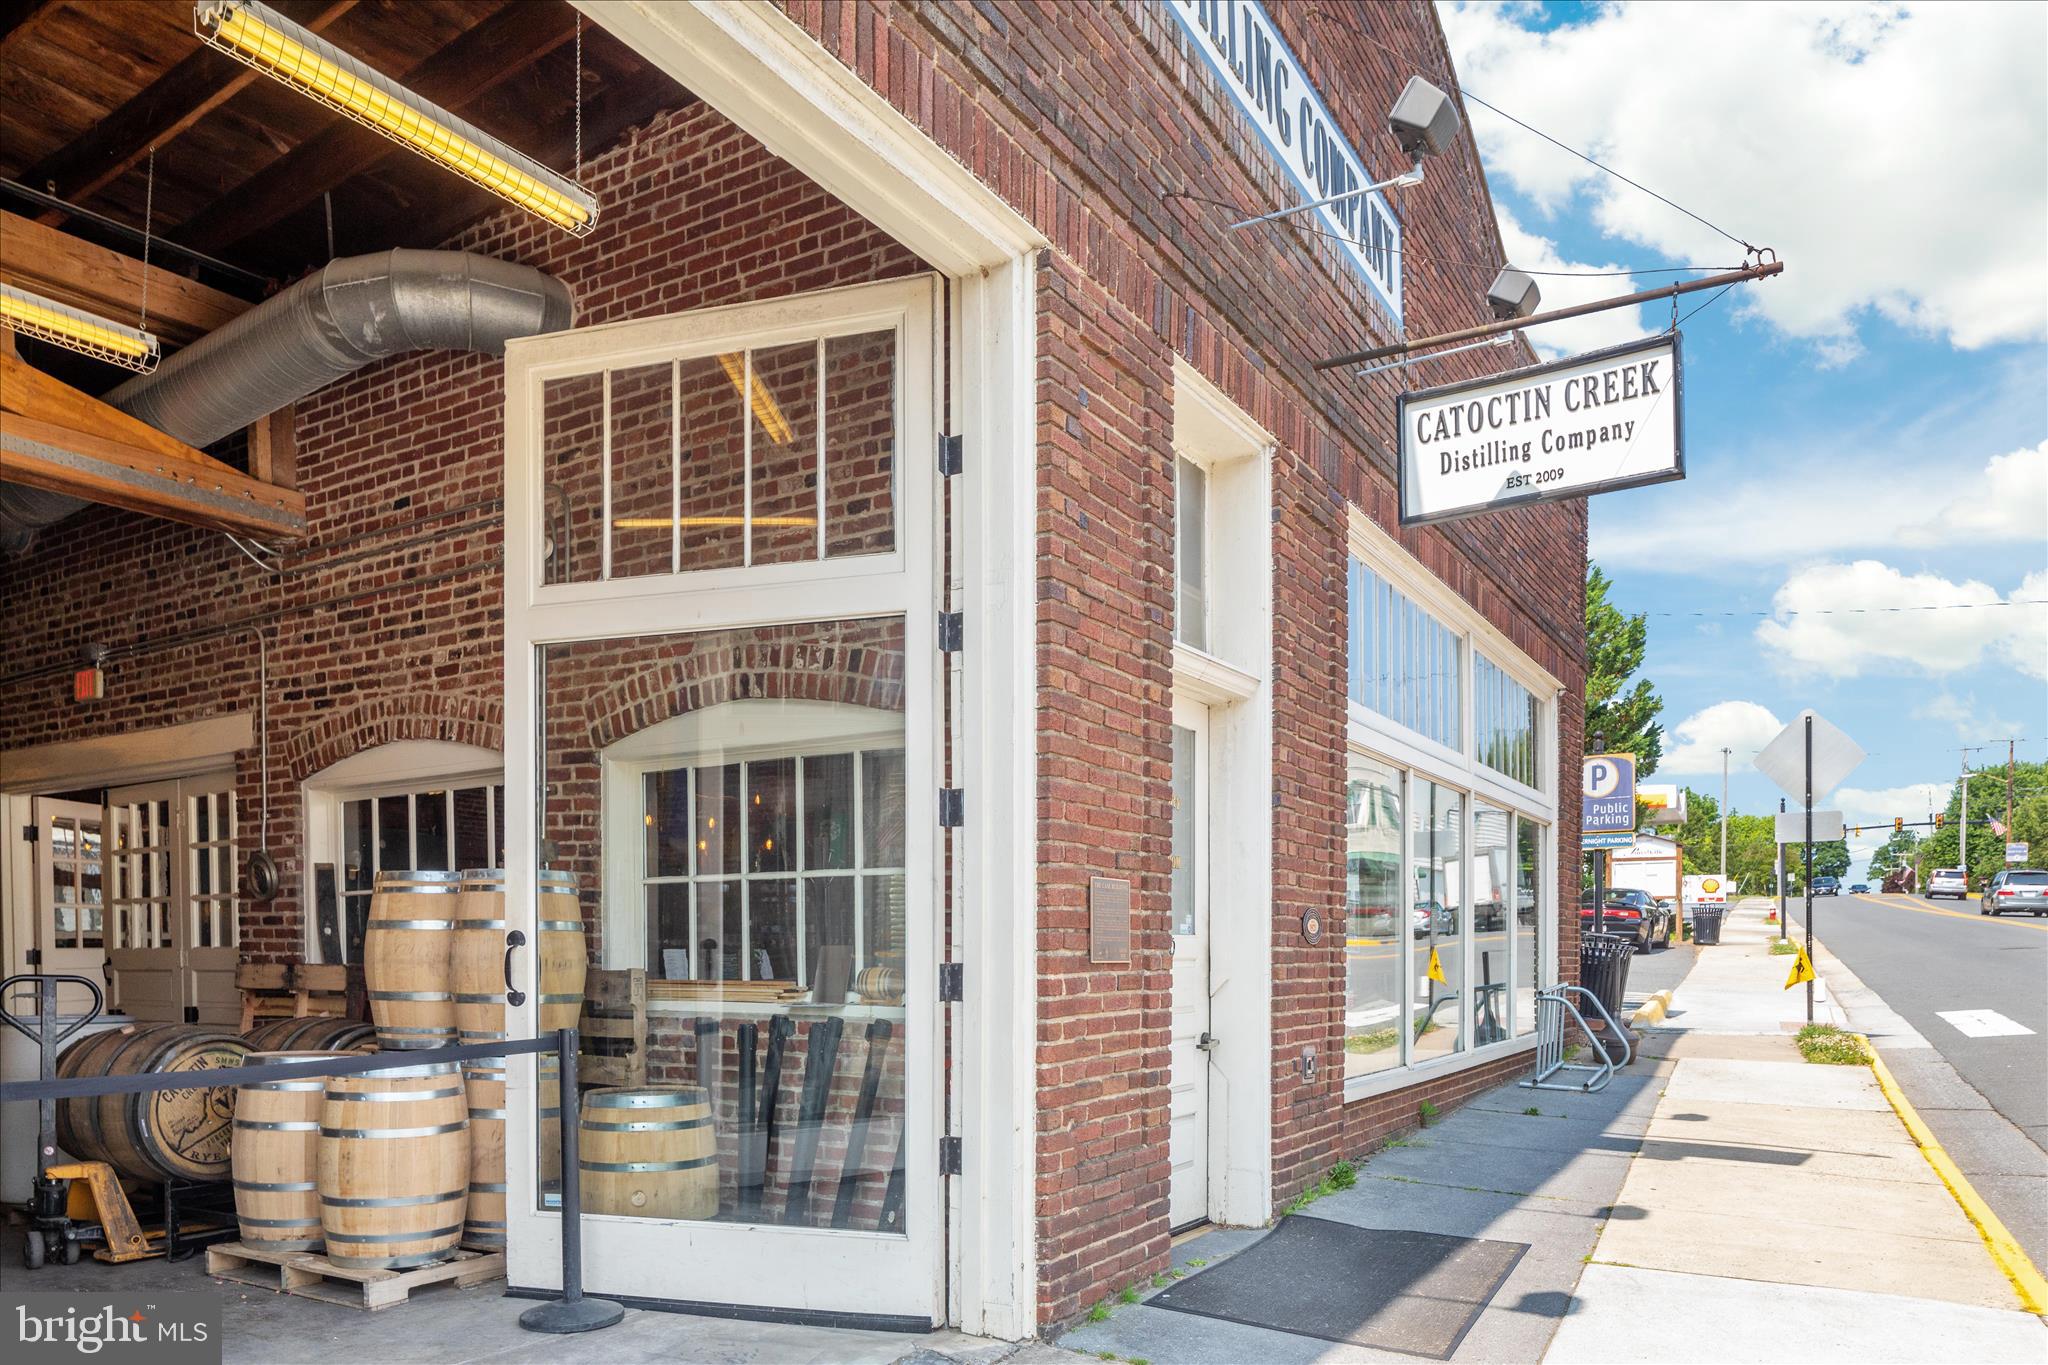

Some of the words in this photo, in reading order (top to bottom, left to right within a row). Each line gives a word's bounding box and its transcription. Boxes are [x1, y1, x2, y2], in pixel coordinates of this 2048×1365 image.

[1299, 96, 1395, 296] COMPANY
[1417, 384, 1552, 444] CATOCTIN
[1564, 360, 1660, 413] CREEK
[1440, 440, 1532, 475] Distilling
[1541, 420, 1636, 454] Company
[1506, 474, 1532, 489] EST
[1535, 468, 1565, 485] 2009
[1593, 803, 1628, 814] Public
[1586, 814, 1629, 826] Parking
[1606, 836, 1633, 845] PARKING
[191, 1151, 221, 1161] RYE
